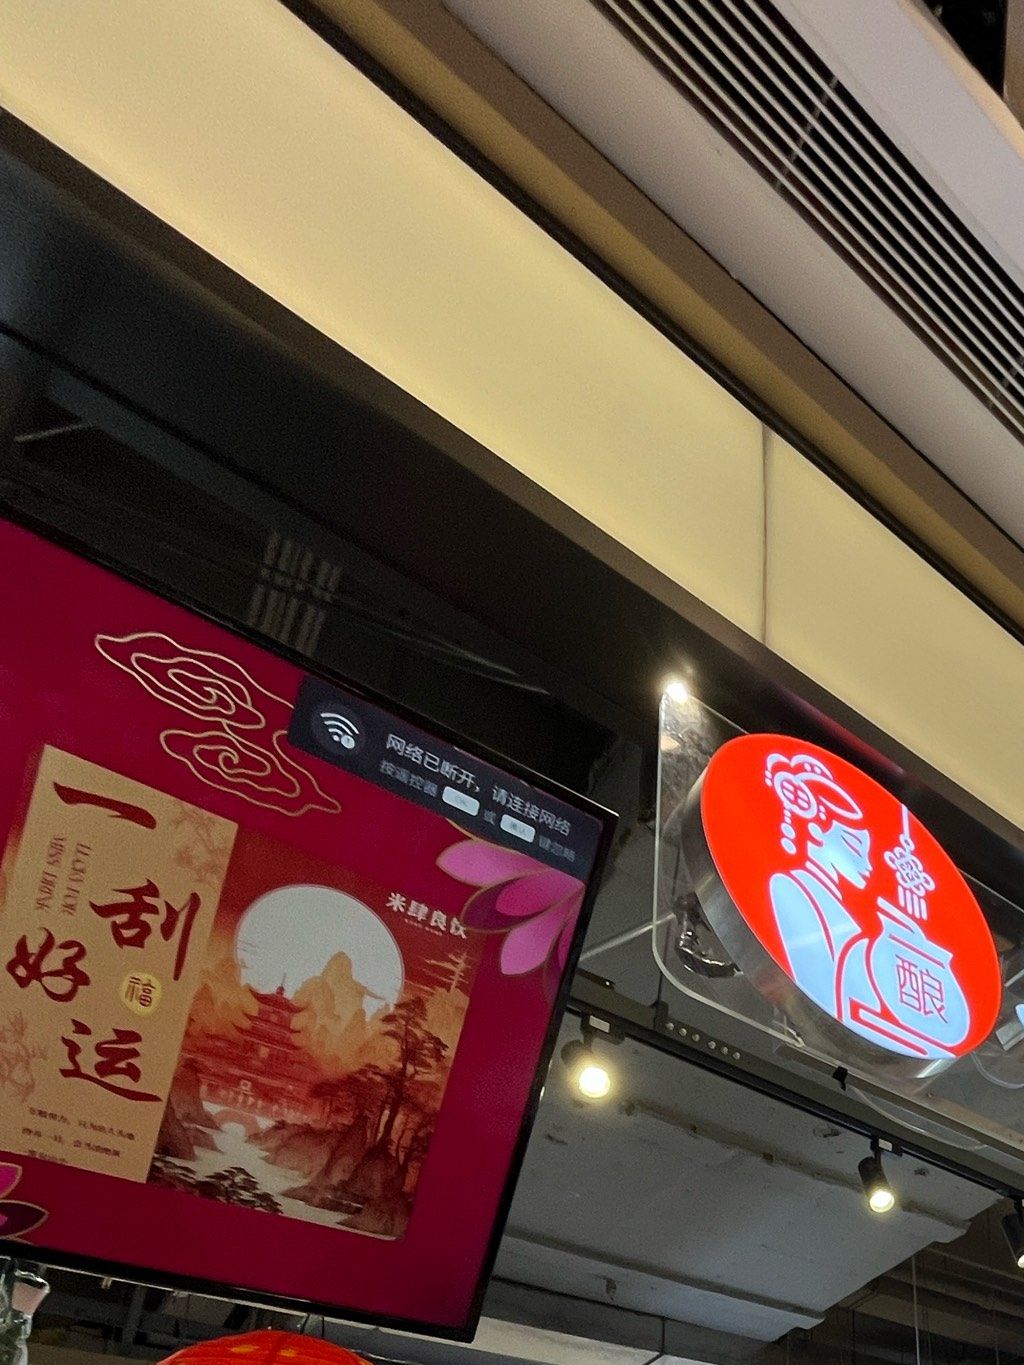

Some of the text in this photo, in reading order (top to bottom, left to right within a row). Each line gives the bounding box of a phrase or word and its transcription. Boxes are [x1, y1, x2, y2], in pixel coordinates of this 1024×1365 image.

[385, 892, 467, 939] 米肆良饮
[123, 975, 155, 1008] 福
[895, 954, 948, 1023] 酿
